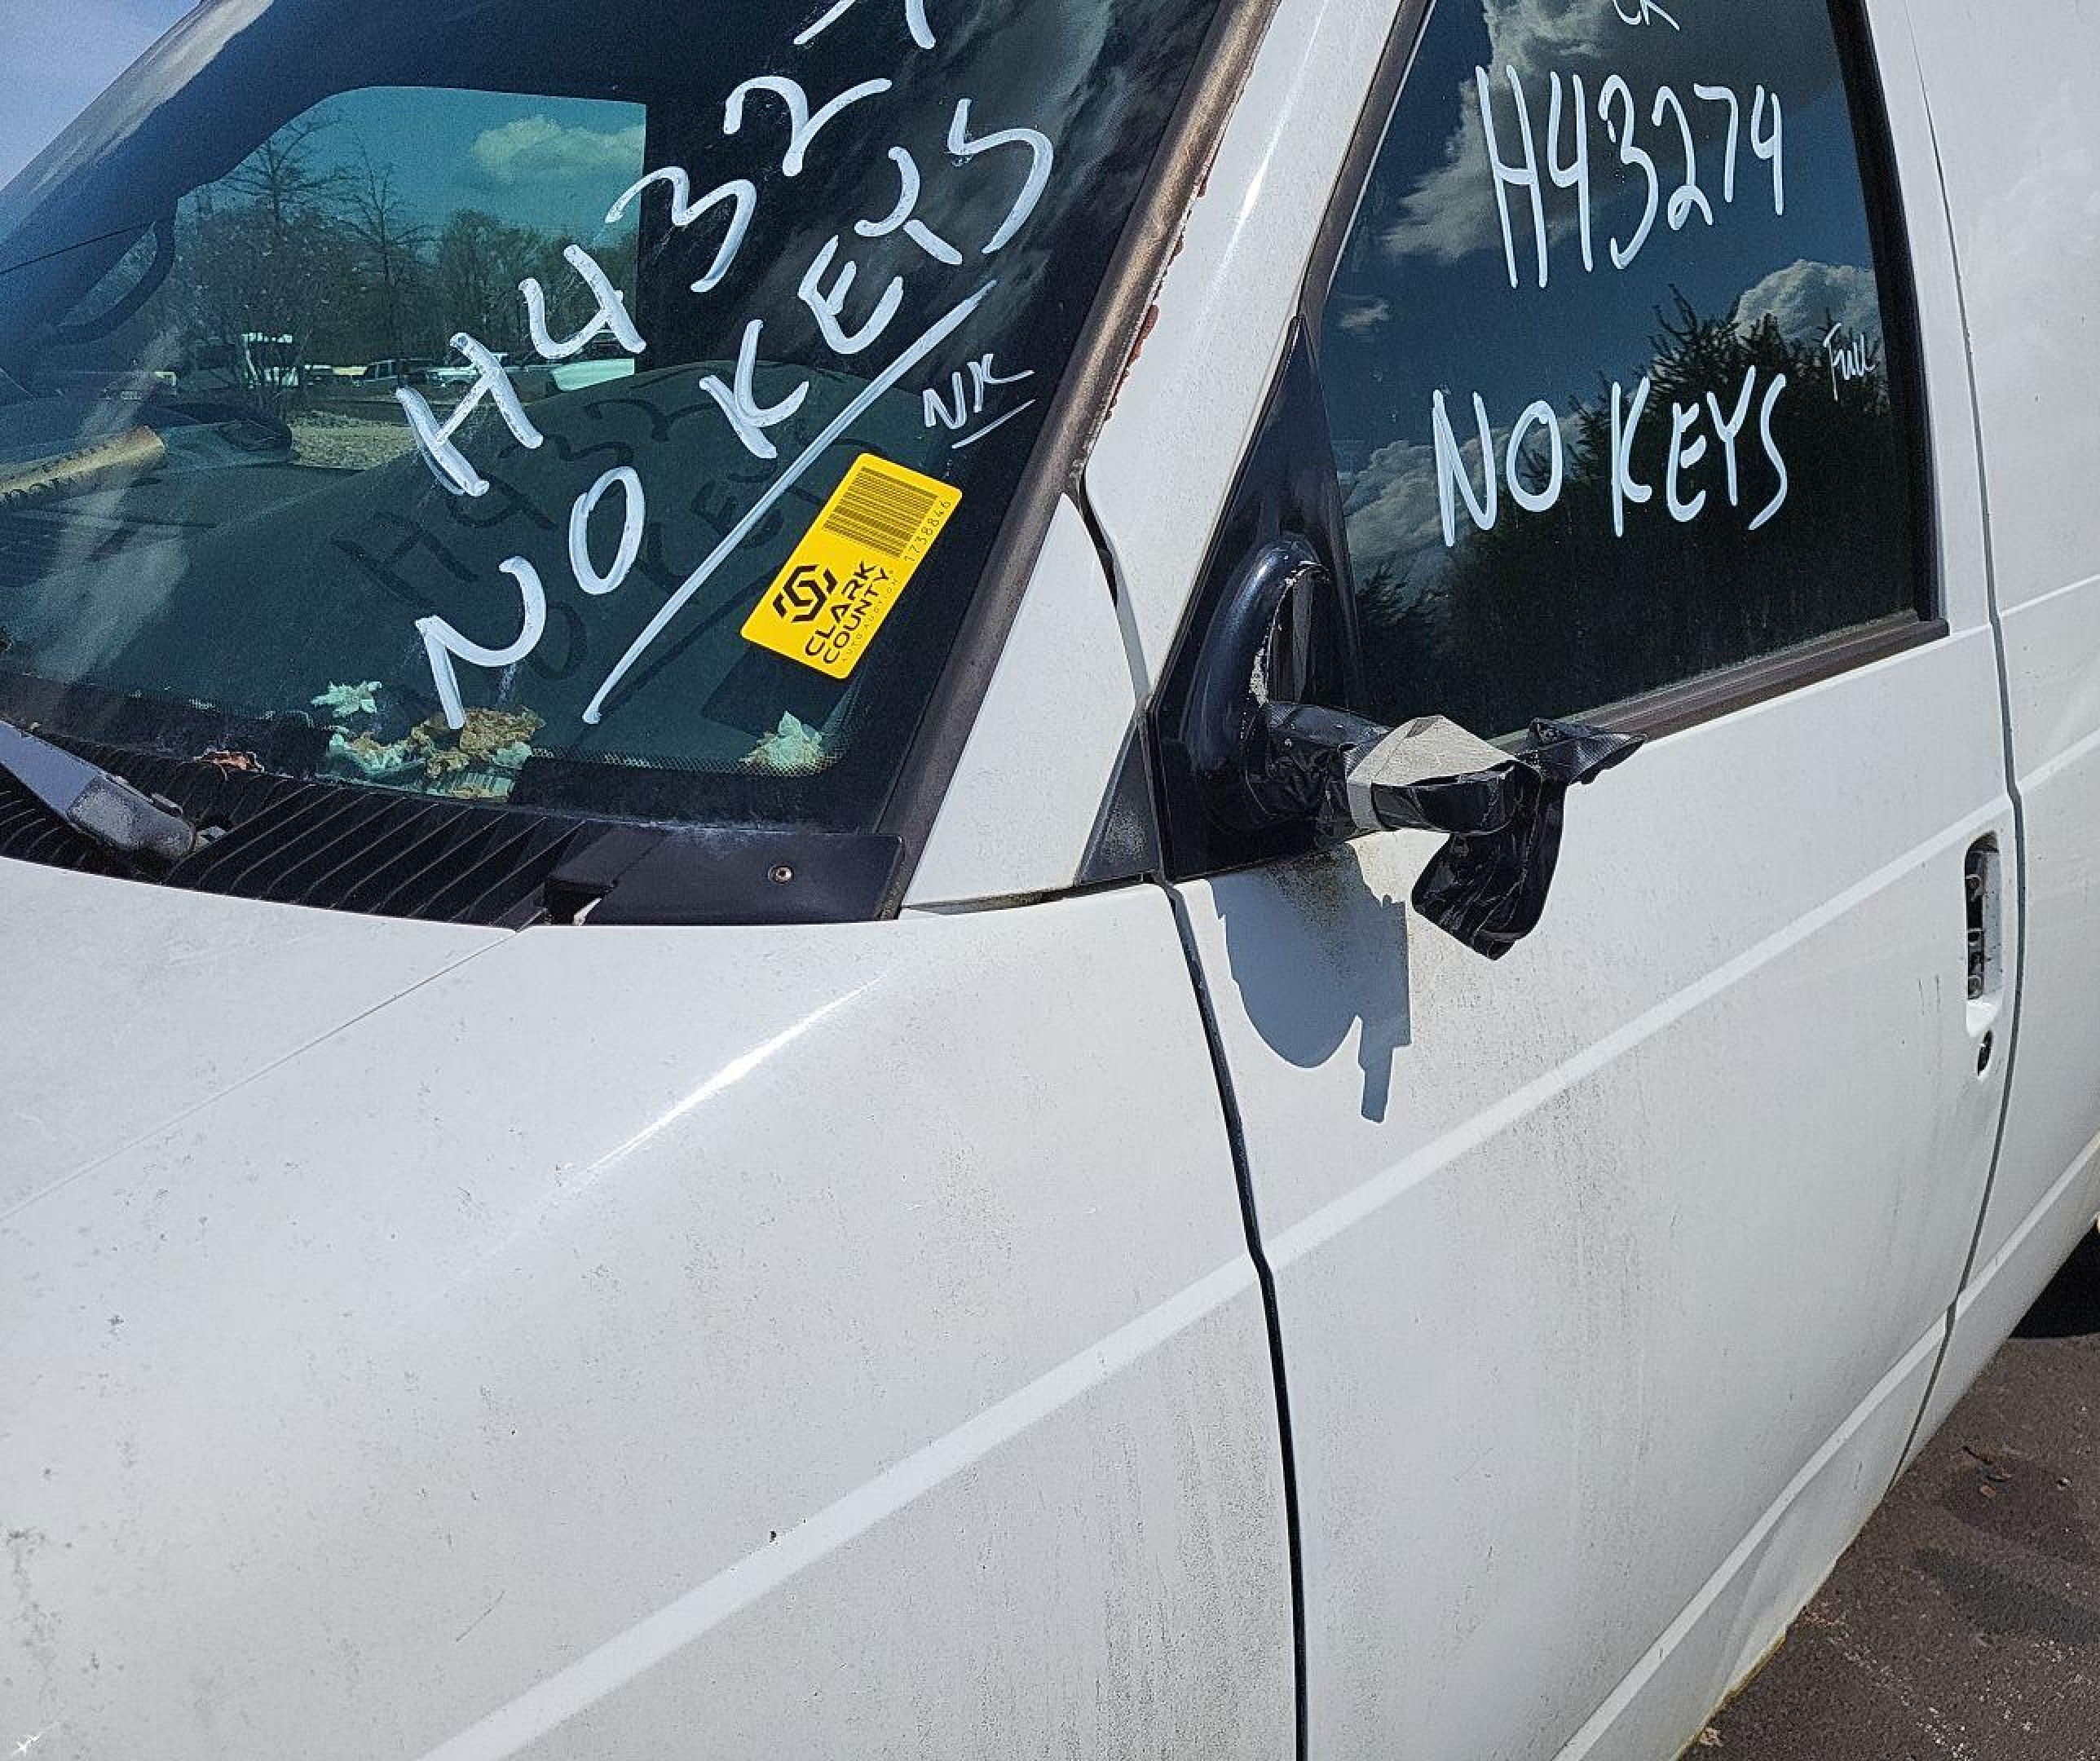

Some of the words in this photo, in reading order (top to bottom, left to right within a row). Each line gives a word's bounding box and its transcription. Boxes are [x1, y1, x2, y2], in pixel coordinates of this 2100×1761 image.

[416, 470, 646, 729] NO
[699, 99, 1054, 459] KEYS
[1433, 390, 1563, 547] NO
[1612, 365, 1789, 538] KEYS
[805, 559, 877, 655] CLARK
[823, 567, 889, 664] COUNTY
